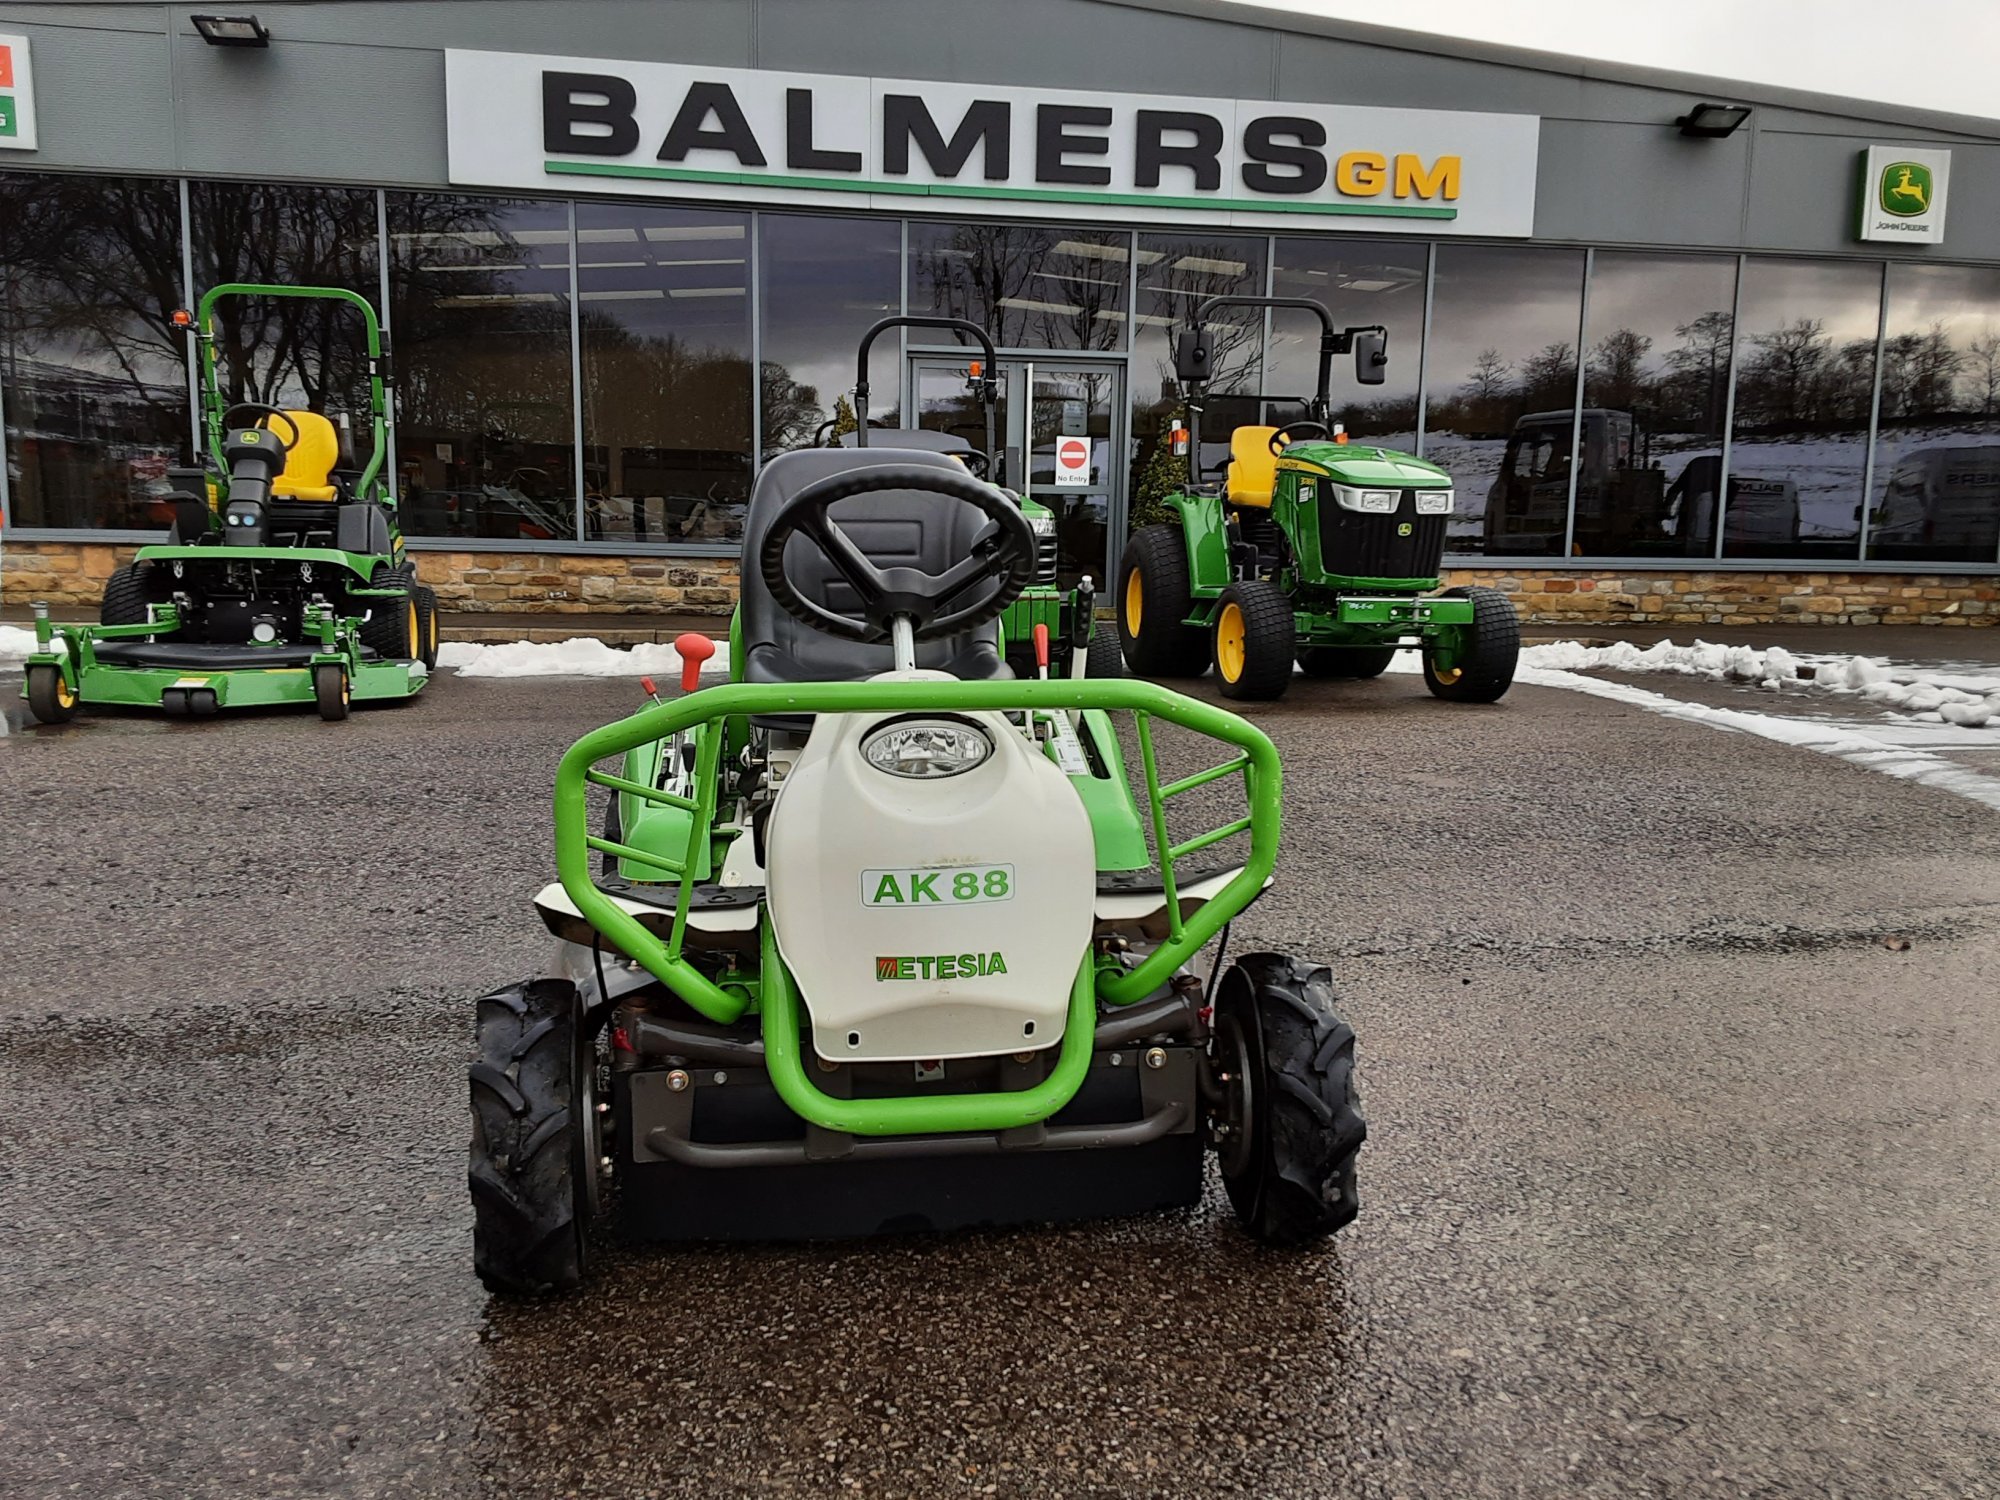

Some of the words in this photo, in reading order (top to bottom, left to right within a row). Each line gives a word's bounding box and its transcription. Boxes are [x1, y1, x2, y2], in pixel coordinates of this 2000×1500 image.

[542, 70, 1327, 194] BALMERS
[1336, 151, 1462, 200] GM
[1876, 221, 1899, 231] JOHN
[1901, 223, 1929, 232] DEERE
[1069, 475, 1087, 483] Entry
[873, 873, 942, 903] AK
[952, 870, 1009, 900] 88
[896, 952, 1008, 980] ETESIA
